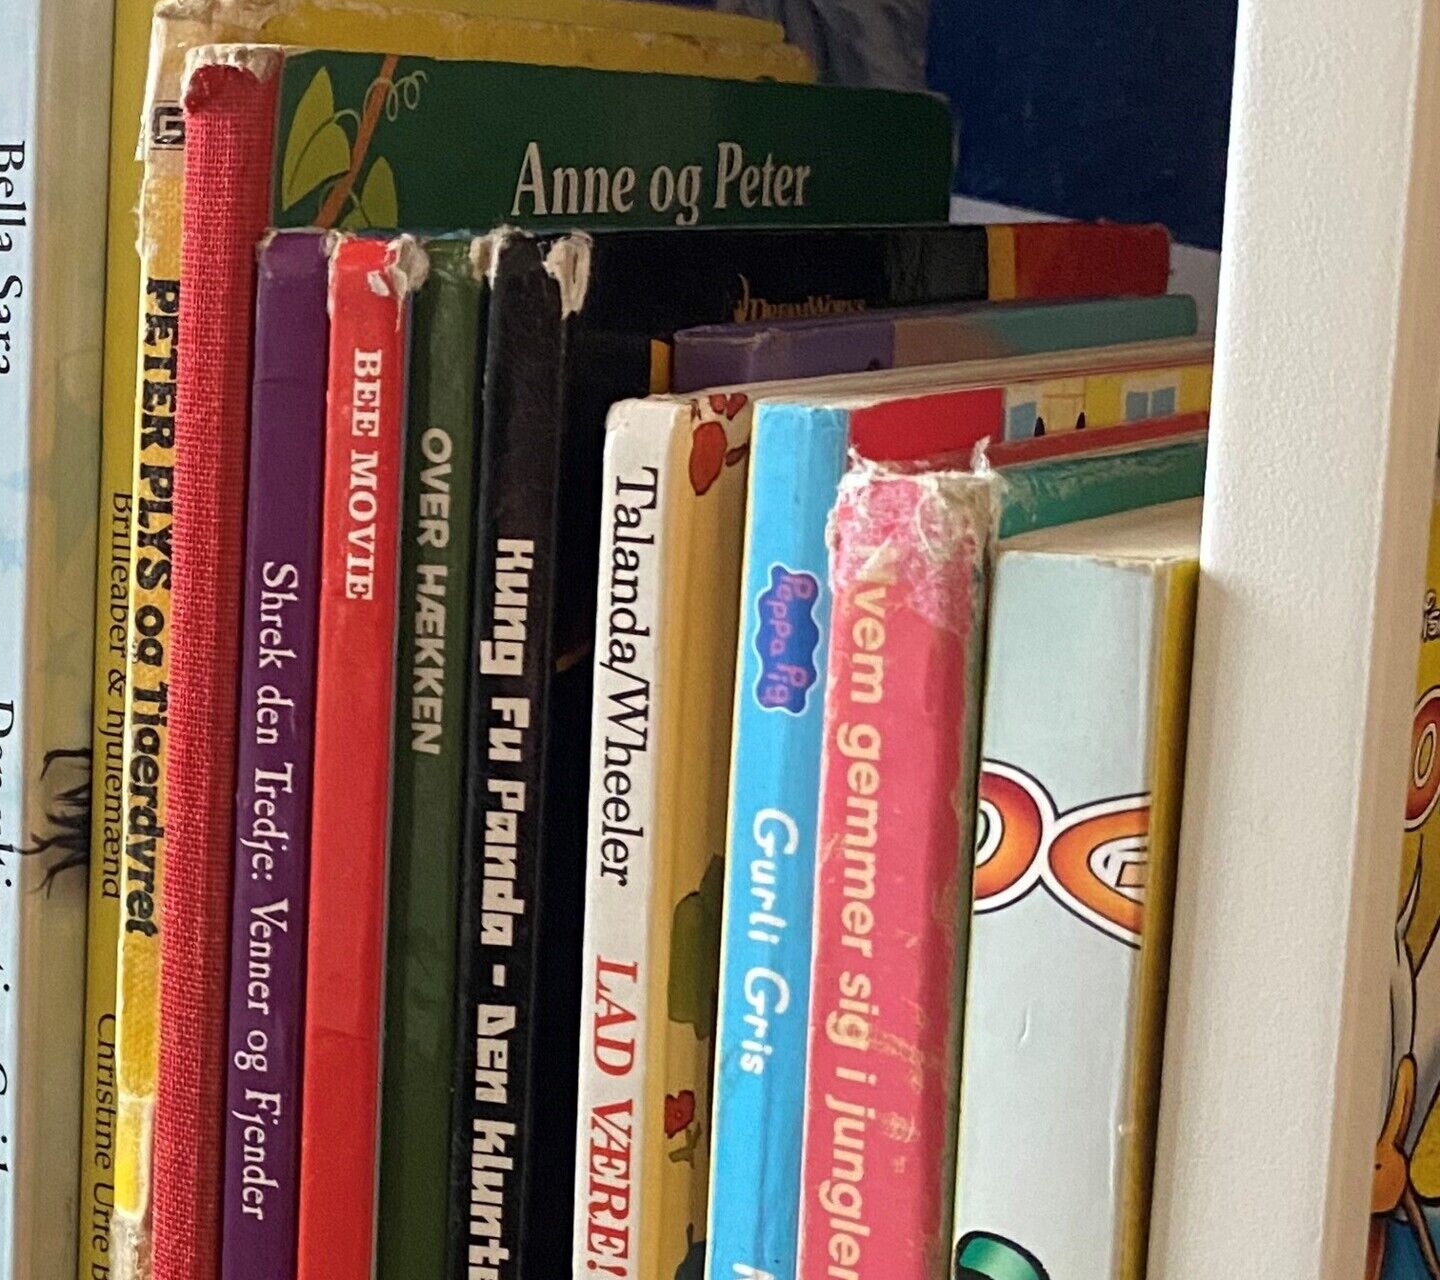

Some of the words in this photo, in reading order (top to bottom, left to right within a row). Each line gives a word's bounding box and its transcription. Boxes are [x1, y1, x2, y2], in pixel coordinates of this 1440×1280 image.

[510, 141, 636, 216] Anne
[649, 163, 703, 226] og
[714, 141, 812, 209] Peter
[140, 277, 180, 449] PETER
[351, 347, 383, 437] BEE
[137, 462, 175, 590] PLYS
[345, 449, 379, 600] MOVIE
[416, 427, 453, 548] OVER
[109, 492, 133, 658] Brilleaber
[259, 560, 299, 669] Shrek
[480, 538, 535, 675] Kung
[768, 573, 815, 657] Peppa
[107, 669, 127, 696] &
[132, 605, 166, 667] og
[411, 563, 449, 754] HÆKKEN
[600, 466, 658, 886] Talanda/Wheeler
[762, 664, 811, 705] Pig
[256, 684, 294, 745] den
[488, 696, 532, 762] Fu
[124, 681, 168, 937] Tigerdyret
[240, 761, 293, 881] Tredje:
[481, 778, 526, 946] Panda
[836, 723, 883, 958] gemmer
[747, 807, 800, 944] Gurli
[247, 897, 289, 1015] Venner
[594, 955, 639, 1076] LAD
[825, 971, 880, 1051] sig
[234, 1029, 270, 1072] og
[475, 1004, 516, 1103] Den
[738, 966, 790, 1076] Gris
[835, 1066, 877, 1085] i
[94, 1012, 117, 1169] Christine
[232, 1088, 282, 1221] Fjender
[587, 1098, 634, 1277] VÆRE!
